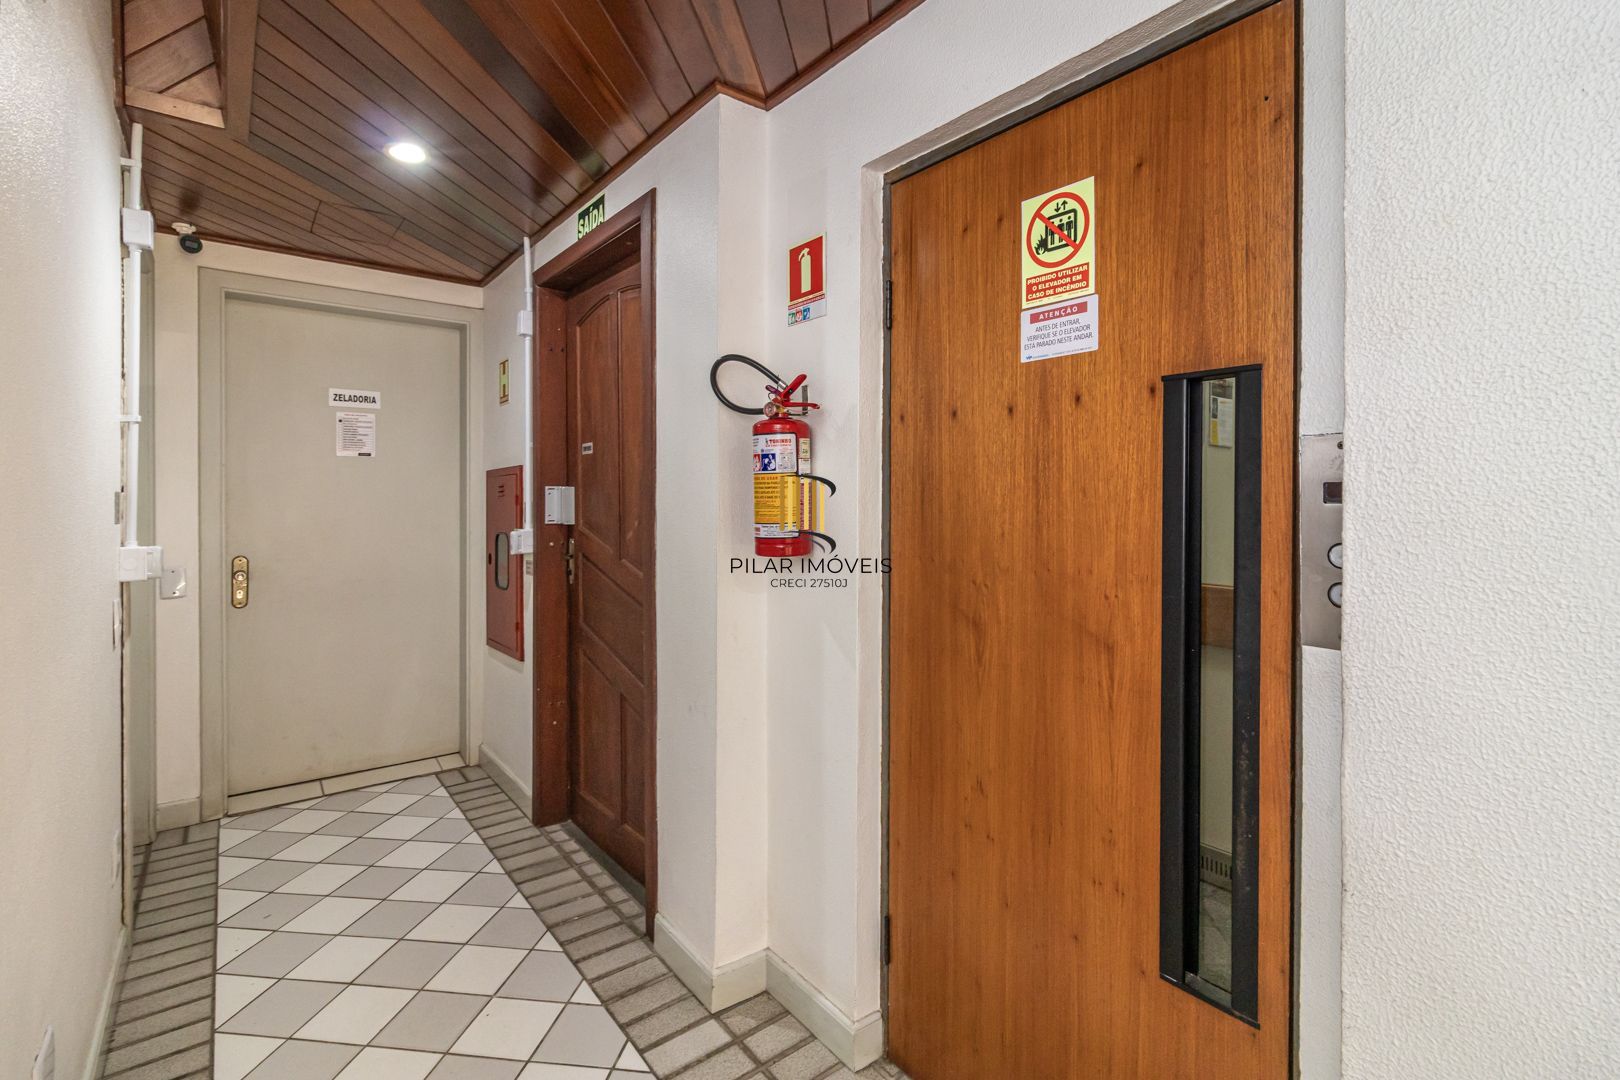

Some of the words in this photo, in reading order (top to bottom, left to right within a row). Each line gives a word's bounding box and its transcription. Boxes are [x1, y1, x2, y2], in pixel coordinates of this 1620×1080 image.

[578, 204, 604, 239] SAÍDA
[1027, 274, 1057, 285] PROIBIDO
[1058, 265, 1088, 277] UTILIZAR
[1038, 278, 1071, 290] ELEVADOR
[1072, 274, 1082, 283] EM
[1028, 291, 1044, 300] CASO
[1055, 281, 1087, 292] INCÊNDIO
[1039, 306, 1078, 320] ATENÇÃO
[1027, 332, 1051, 342] VERIFIQUE
[1064, 324, 1091, 335] ELEVADOR
[1035, 324, 1051, 332] ANTES
[1036, 338, 1057, 348] PARADO
[1056, 335, 1073, 344] NESTE
[333, 393, 377, 404] ZELADORIA
